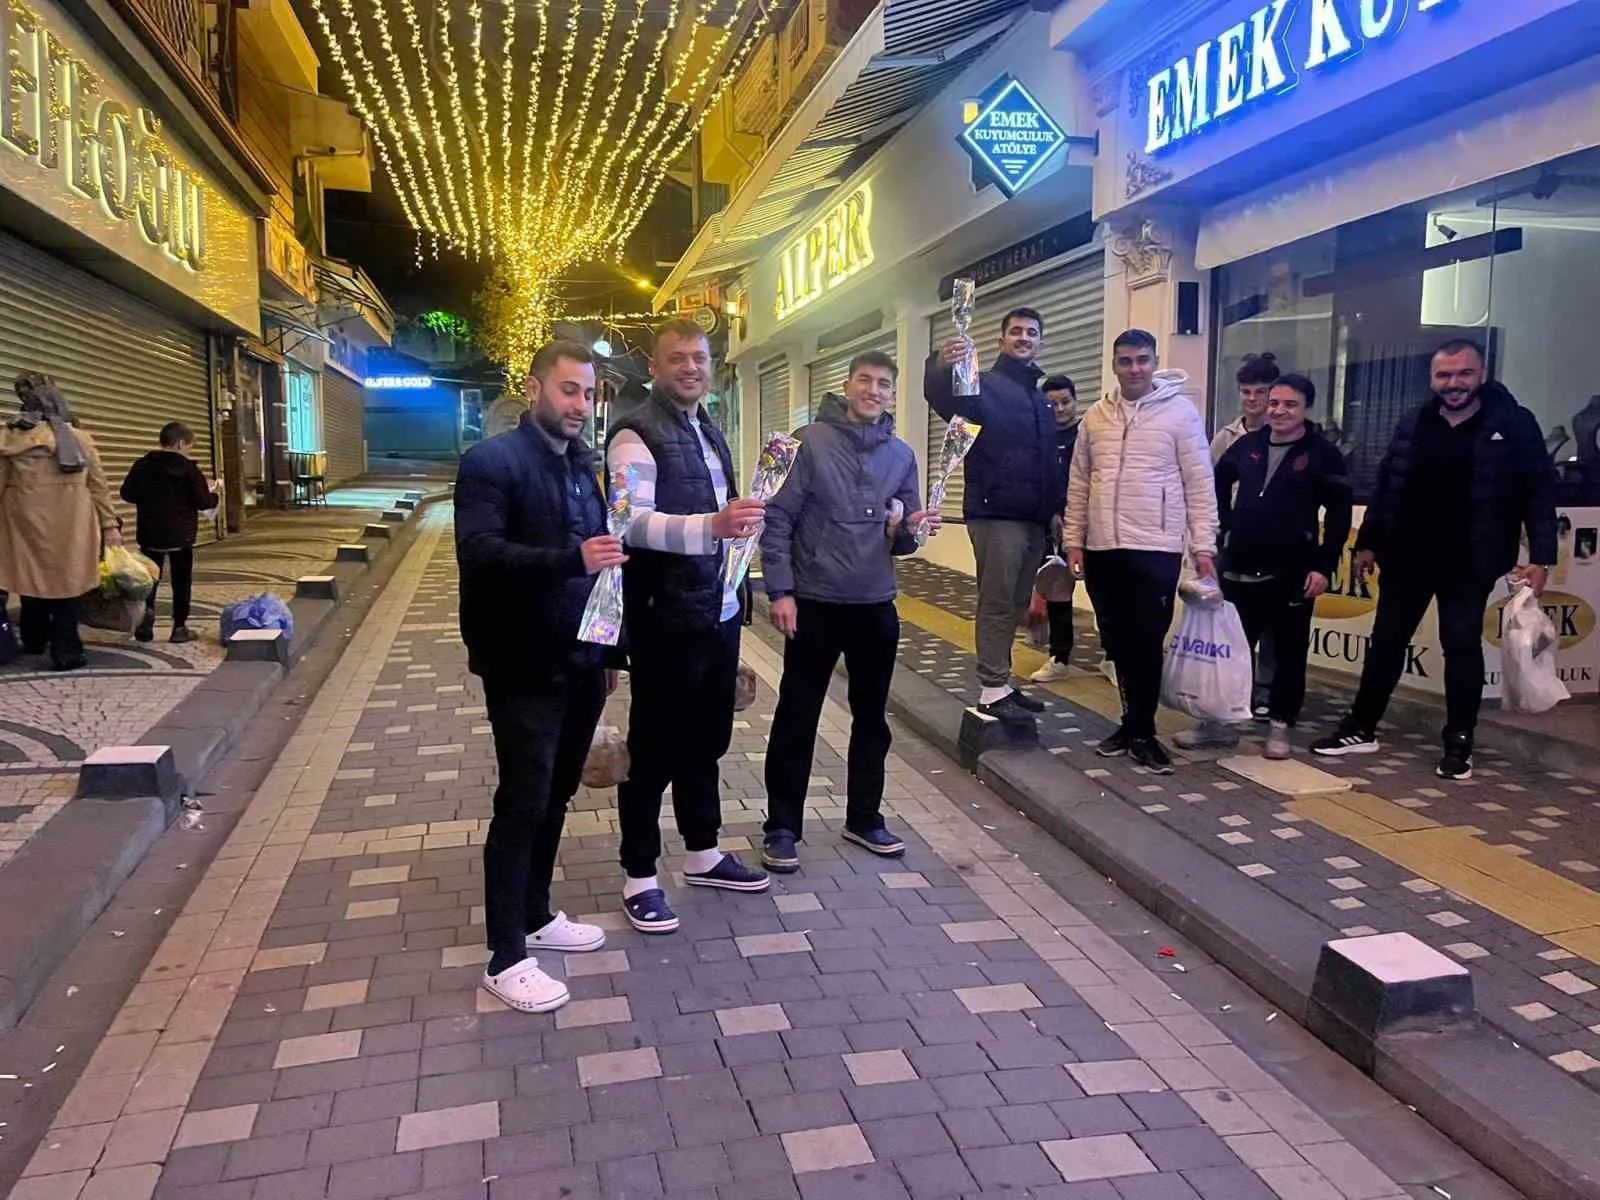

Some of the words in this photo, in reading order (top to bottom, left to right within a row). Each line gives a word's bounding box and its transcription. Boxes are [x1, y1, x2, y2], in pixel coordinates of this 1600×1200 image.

[1145, 0, 1286, 153] EMEK
[990, 111, 1040, 128] EMEK
[974, 129, 1054, 143] KUYUMCULUK
[992, 142, 1037, 154] ATÖLYE
[776, 185, 873, 320] ALPER
